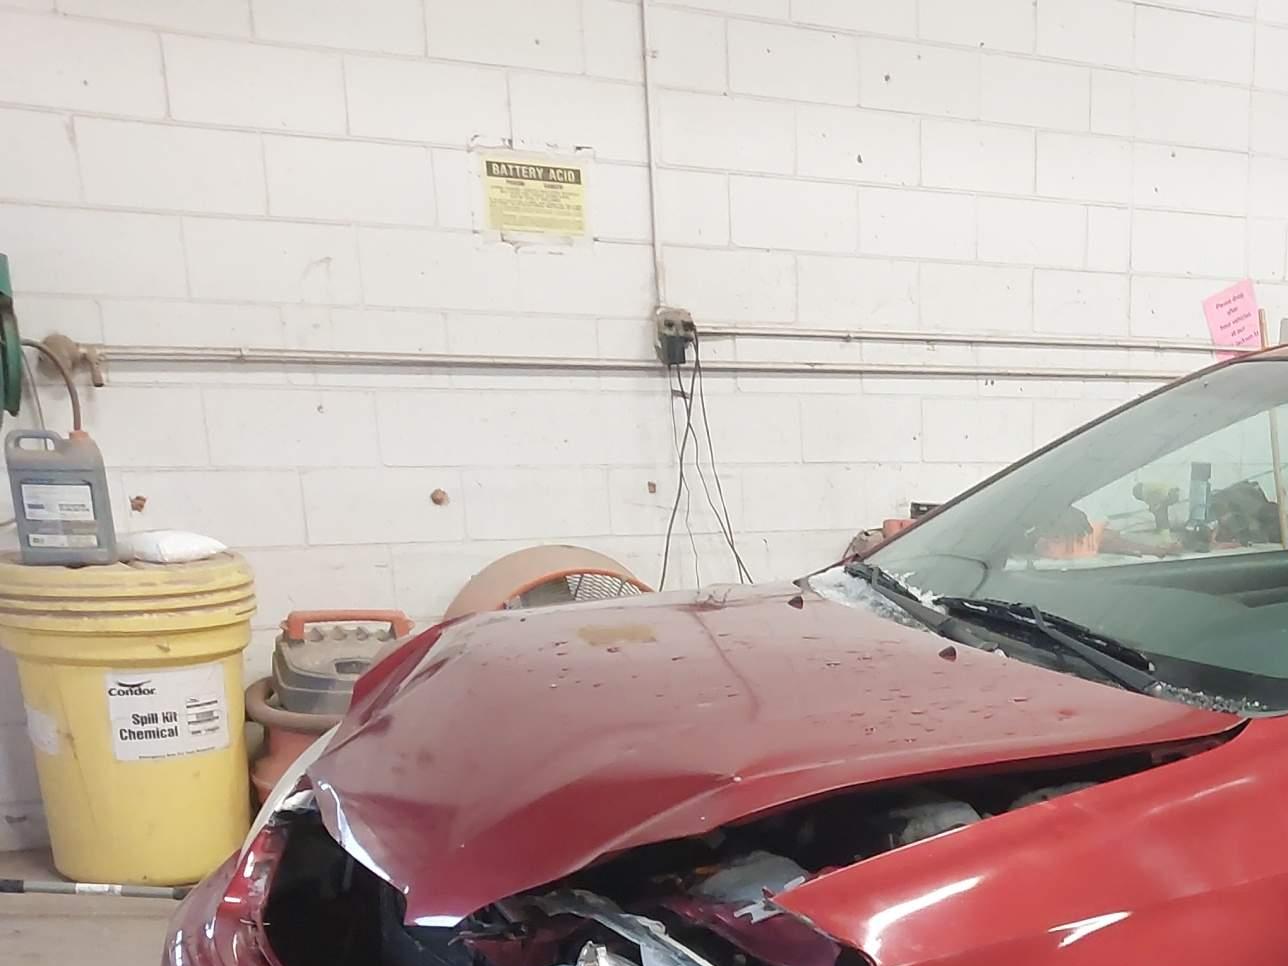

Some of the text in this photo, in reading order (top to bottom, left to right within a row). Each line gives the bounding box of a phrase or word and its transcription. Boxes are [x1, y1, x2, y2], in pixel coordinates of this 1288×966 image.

[492, 163, 575, 182] BATTERY ACID
[108, 687, 156, 697] Condor
[132, 712, 159, 727] Spill
[162, 711, 178, 723] Kit
[119, 726, 179, 741] Chemical
